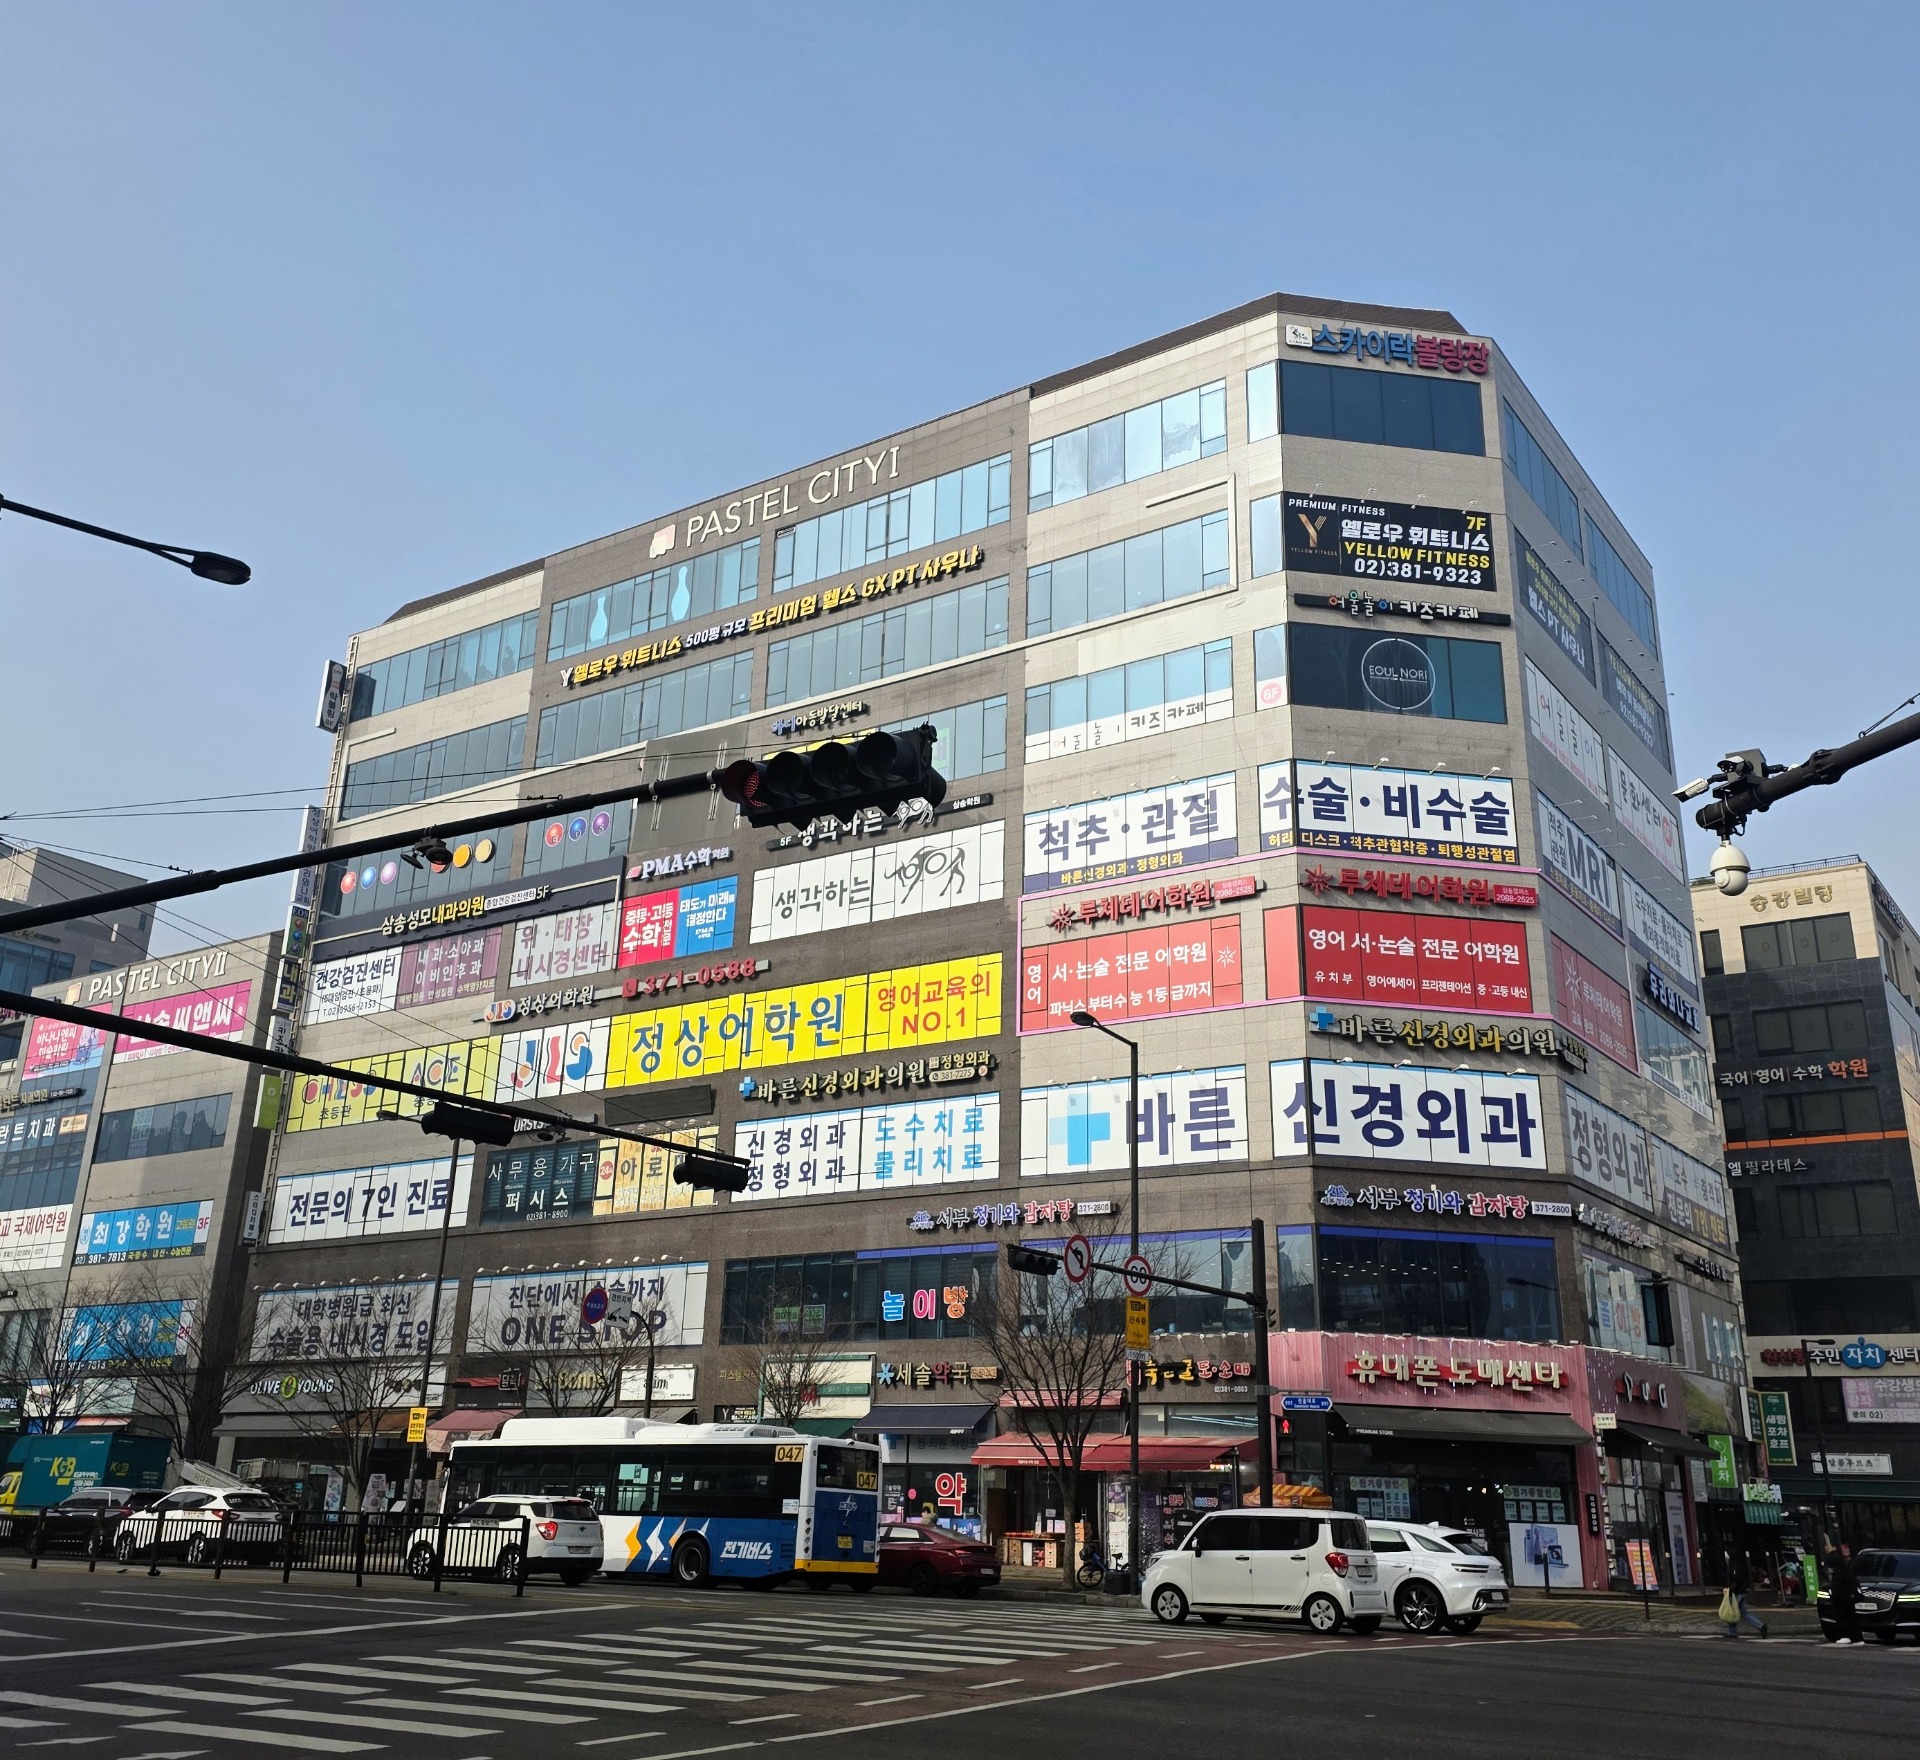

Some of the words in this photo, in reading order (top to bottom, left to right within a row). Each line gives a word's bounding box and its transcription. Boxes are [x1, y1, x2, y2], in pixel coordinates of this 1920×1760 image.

[686, 484, 799, 547] PASTEL
[1288, 499, 1336, 511] PREMIUM
[1341, 504, 1385, 516] FITNESS
[1466, 516, 1487, 530] 7F
[1342, 519, 1403, 542] 옐로우
[1408, 526, 1490, 551] 휘트니스
[1344, 541, 1414, 560] YELLOW
[1417, 549, 1490, 568] FITNESS
[1354, 558, 1482, 585] 02)381-9323
[573, 654, 620, 684] 옐로우
[620, 636, 682, 668] 휘트니스
[686, 625, 720, 648] 500평
[720, 617, 747, 638] 규모
[749, 594, 818, 631] 프리미엄
[822, 582, 857, 611] 헬스
[861, 573, 889, 598] GX
[890, 563, 920, 590] PT
[920, 544, 980, 580] 사우나
[1400, 600, 1479, 620] 키즈카페
[1369, 665, 1398, 678] EOUL
[1400, 668, 1427, 680] NORI
[1263, 687, 1279, 700] 6F
[1131, 701, 1204, 730] 키즈카페
[780, 836, 792, 847] 5F
[1269, 833, 1293, 846] 허리
[1566, 825, 1610, 908] MRI
[537, 886, 550, 899] 5F
[775, 874, 870, 919] 생각하는
[1077, 891, 1140, 925] 루체테
[1144, 880, 1210, 913] 어학원
[1338, 867, 1412, 900] 루체테
[1417, 875, 1491, 906] 어학원
[292, 907, 308, 918] EOS
[623, 924, 661, 953] 수학
[1309, 929, 1346, 950] 영어
[1422, 938, 1459, 960] 전문
[1464, 941, 1520, 965] 어학원
[516, 941, 608, 981] 내시경센터
[1115, 951, 1149, 973] 전문
[1155, 941, 1207, 967] 어학원
[88, 967, 161, 1001] PASTEL
[281, 964, 297, 1003] 내과
[316, 957, 396, 991] 건강검진센터
[643, 958, 756, 994] 371-0588
[517, 984, 595, 1017] 정상어학원
[878, 974, 990, 1012] 영어교육의
[1510, 986, 1528, 999] 내신
[633, 995, 843, 1073] 정상어학원
[901, 1009, 967, 1035] NO.1
[511, 1031, 593, 1089] JLS
[941, 1050, 990, 1069] 정형외과
[1720, 1071, 1748, 1087] 국어
[1756, 1066, 1785, 1083] 영어
[1793, 1064, 1823, 1080] 수학
[1827, 1058, 1868, 1080] 학원
[757, 1060, 925, 1101] 바른신경외과의원
[320, 1104, 352, 1121] 초등관
[875, 1107, 984, 1141] 도수치료
[1126, 1087, 1236, 1156] 바른
[1283, 1079, 1537, 1158] 신경외과
[748, 1121, 846, 1158] 신경외과
[1571, 1106, 1650, 1202] 정형외과
[874, 1145, 983, 1180] 물리치료
[1746, 1157, 1808, 1174] 필라테스
[290, 1187, 353, 1227] 전문의
[362, 1182, 398, 1217] 7인
[407, 1178, 450, 1216] 진료
[505, 1187, 570, 1213] 퍼시스
[937, 1207, 970, 1228] 서부
[973, 1203, 1021, 1227] 청기와
[1023, 1199, 1075, 1224] 감자탕
[1357, 1185, 1401, 1209] 서부
[1404, 1188, 1464, 1215] 청기와
[1467, 1192, 1529, 1219] 감자탕
[1535, 1204, 1570, 1214] 371-2800
[14, 1211, 67, 1237] 국제어학원
[93, 1211, 172, 1245] 최강학원
[197, 1216, 210, 1230] 3F
[298, 1295, 375, 1320] 대학병원급
[380, 1292, 412, 1316] 최신
[508, 1282, 580, 1309] 진단에서
[882, 1286, 968, 1321] 놀이방
[329, 1323, 389, 1353] 내시경
[501, 1314, 567, 1346] ONE
[1354, 1350, 1441, 1387] 휴대폰
[1450, 1358, 1563, 1391] 도매센타
[1810, 1348, 1841, 1365] 주민
[1848, 1347, 1881, 1364] 자치
[1888, 1347, 1920, 1365] 센터
[250, 1380, 280, 1395] OLIVE
[297, 1379, 334, 1394] YOUNG
[896, 1361, 969, 1386] 세솔약국
[778, 1447, 802, 1461] 047
[858, 1474, 876, 1488] 047
[935, 1473, 966, 1516] 약
[720, 1541, 773, 1560] 전기버스
